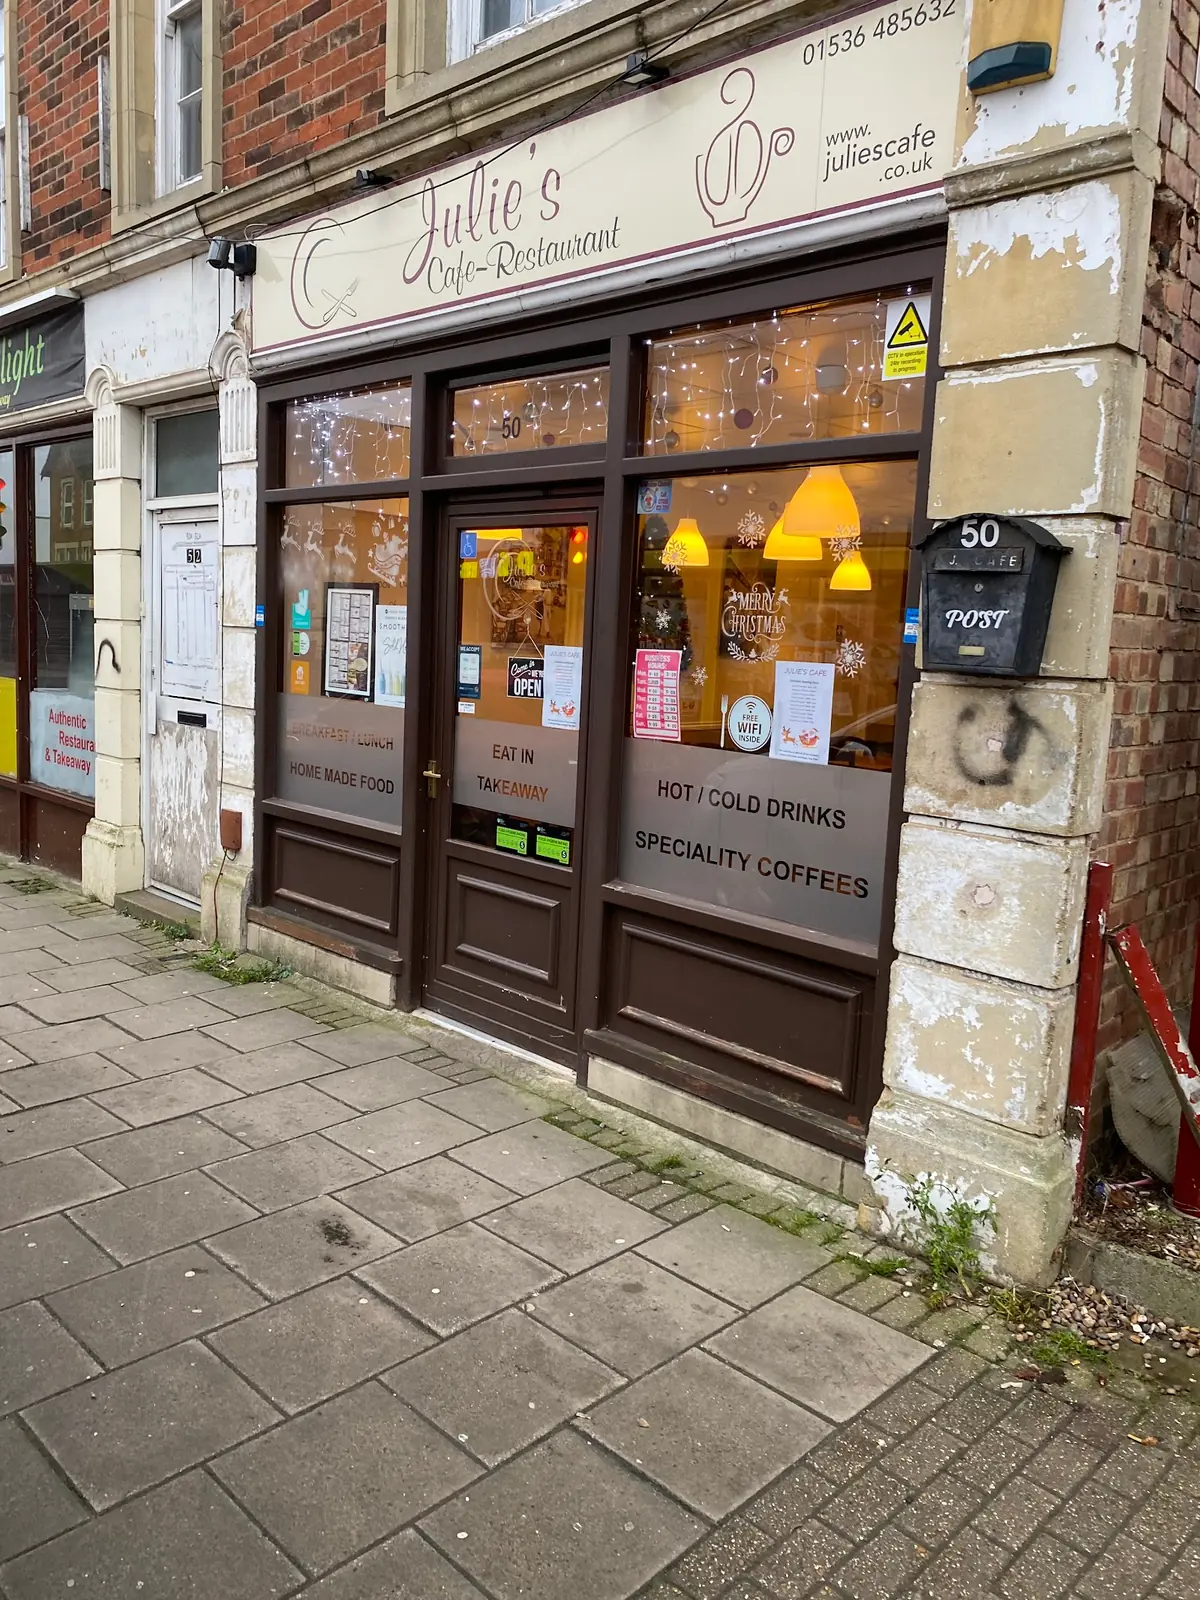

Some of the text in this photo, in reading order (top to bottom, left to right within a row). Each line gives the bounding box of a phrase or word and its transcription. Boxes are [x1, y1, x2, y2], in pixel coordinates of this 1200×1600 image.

[803, 0, 956, 65] 01536 485632
[826, 124, 871, 147] www.
[823, 123, 936, 182] juliescafe
[879, 152, 933, 182] .co.uk
[402, 142, 560, 285] Julie's
[502, 416, 521, 439] 50
[960, 519, 1000, 548] 50
[187, 549, 201, 563] 52
[949, 555, 1018, 567] J. CAFE
[737, 582, 780, 613] MERRY
[721, 605, 787, 643] CHRISTMAS
[945, 609, 1010, 629] POST
[511, 663, 528, 676] Come
[784, 668, 828, 677] JULIE'S CAFE
[514, 678, 541, 697] OPEN
[49, 708, 87, 729] Authentic
[738, 722, 762, 735] WIFI
[743, 714, 758, 722] FREE
[59, 730, 95, 752] Restaura
[292, 722, 349, 742] BREAKFAST
[357, 733, 394, 750] LUNCH
[739, 734, 760, 743] INSIDE
[45, 747, 91, 775] & Takeaway
[493, 744, 534, 765] EAT IN
[290, 761, 395, 794] HOME MADE FOOD
[477, 775, 549, 802] TAKEAWAY
[657, 779, 846, 829] HOT / COLD DRINKS
[635, 830, 869, 898] SPECIALITY COFFEES
